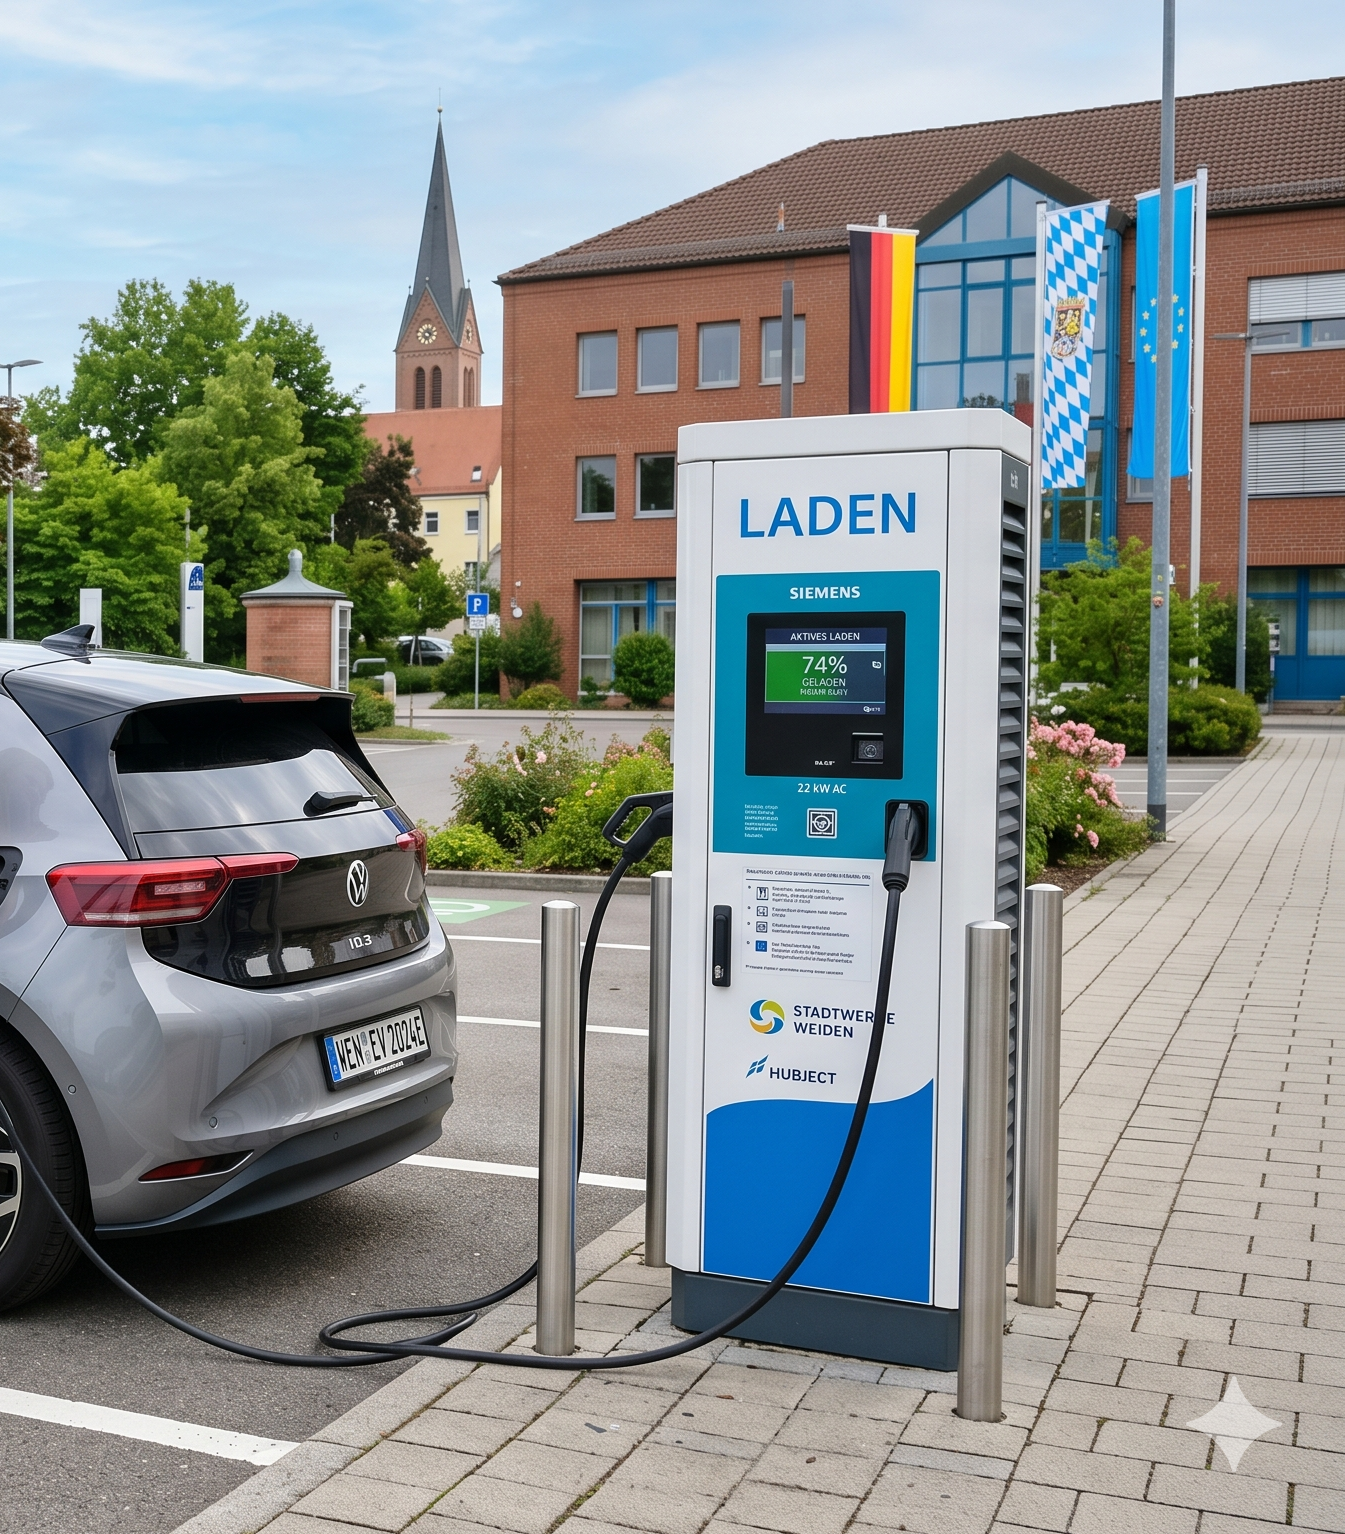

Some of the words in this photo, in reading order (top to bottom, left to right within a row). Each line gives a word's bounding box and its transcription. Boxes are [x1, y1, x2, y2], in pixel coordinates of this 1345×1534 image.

[740, 492, 916, 538] LADEN
[789, 586, 861, 600] SIEMENS
[473, 598, 482, 612] P
[790, 632, 827, 641] AKTIVES
[829, 632, 860, 641] LADEN
[802, 655, 848, 674] 74%
[797, 783, 811, 793] 22
[813, 783, 831, 794] kW
[832, 784, 847, 794] AC
[793, 1004, 896, 1025] STADTWERE
[387, 1015, 425, 1055] 2024E
[793, 1021, 854, 1038] WEIDEN
[769, 1066, 837, 1085] HUBJECT
